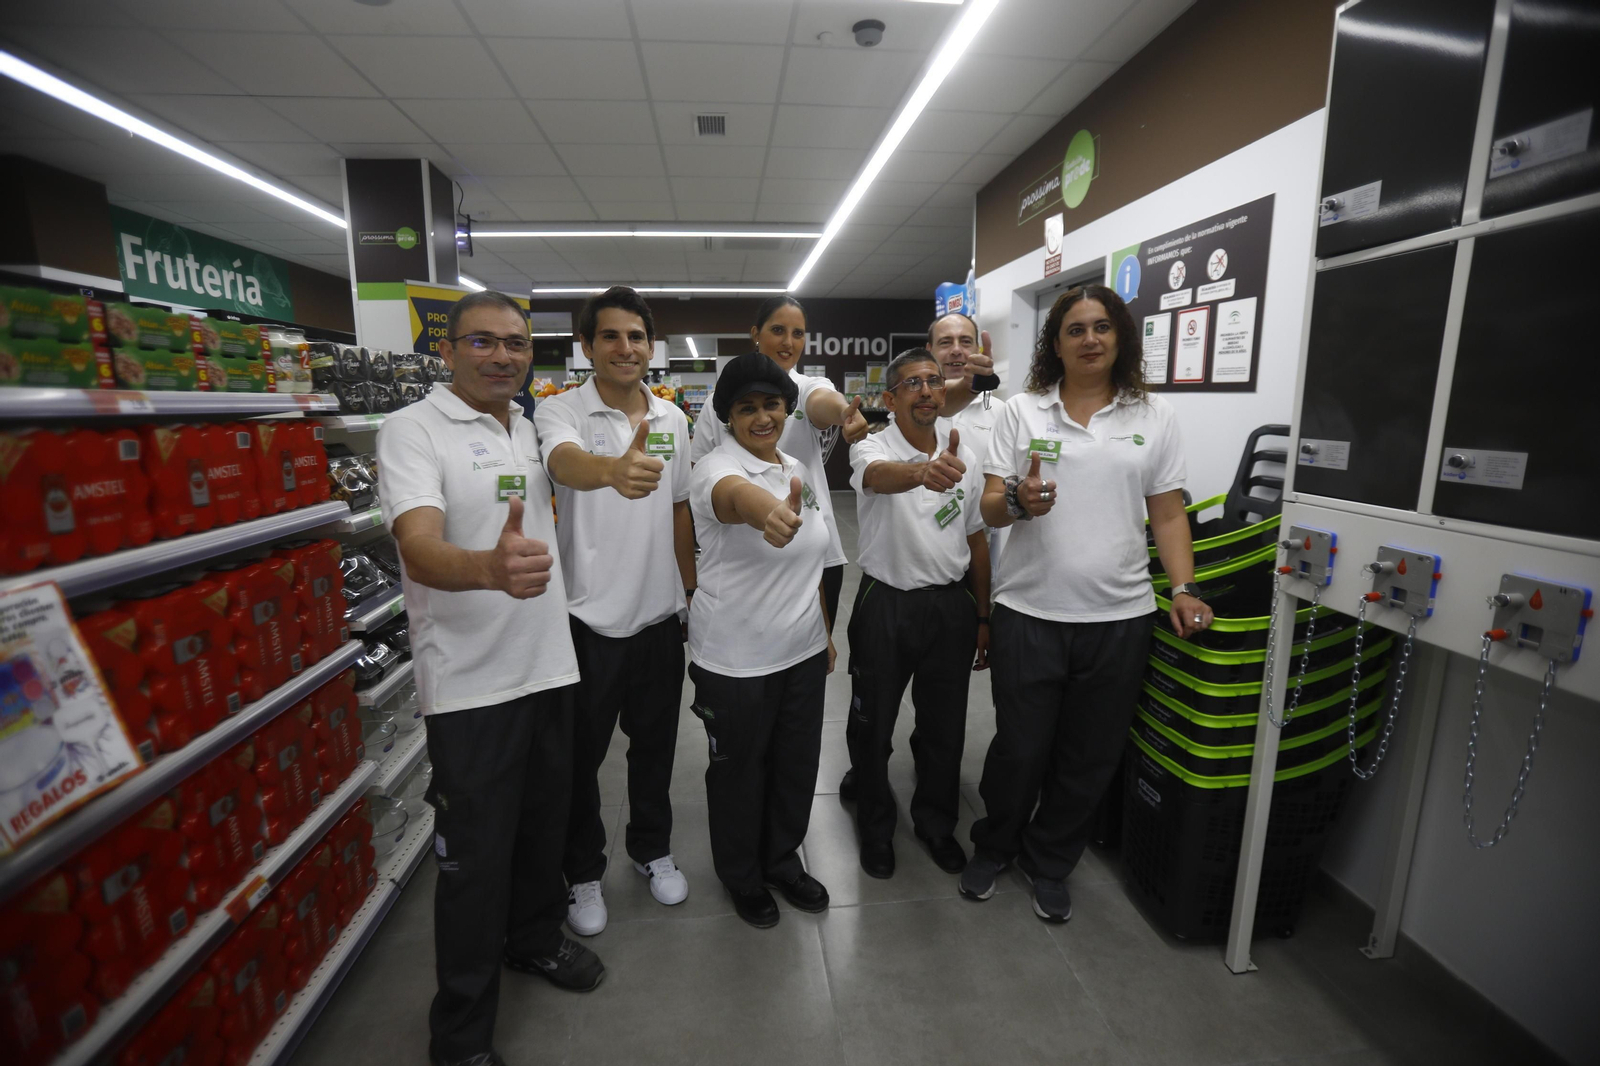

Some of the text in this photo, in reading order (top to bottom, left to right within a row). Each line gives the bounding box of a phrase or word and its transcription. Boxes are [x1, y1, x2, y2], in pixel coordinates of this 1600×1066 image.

[1019, 176, 1062, 218] prossima
[361, 234, 394, 242] prossima
[1148, 247, 1154, 255] En
[1154, 238, 1184, 252] cumplimiento
[1184, 234, 1191, 242] de
[1197, 223, 1225, 238] normativa
[1225, 215, 1248, 229] vigente
[120, 232, 263, 306] Frutería
[1147, 249, 1179, 266] INFORMAMOS
[949, 297, 962, 310] BIMBO
[92, 318, 104, 331] 6
[193, 331, 201, 342] 6
[263, 340, 270, 350] 6
[804, 332, 888, 356] Horno
[99, 364, 112, 377] 6
[199, 370, 207, 381] 6
[268, 374, 275, 383] 6
[207, 464, 242, 480] AMSTEL
[294, 455, 318, 467] AMSTEL
[73, 479, 126, 501] AMSTEL
[325, 596, 334, 635] AMSTEL
[269, 621, 284, 665] AMSTEL
[197, 658, 215, 707] AMSTEL
[340, 722, 352, 758] AMSTEL
[292, 763, 304, 802] AMSTEL
[10, 769, 87, 834] REGALOS
[228, 815, 244, 862] AMSTEL
[133, 885, 154, 940] AMSTEL
